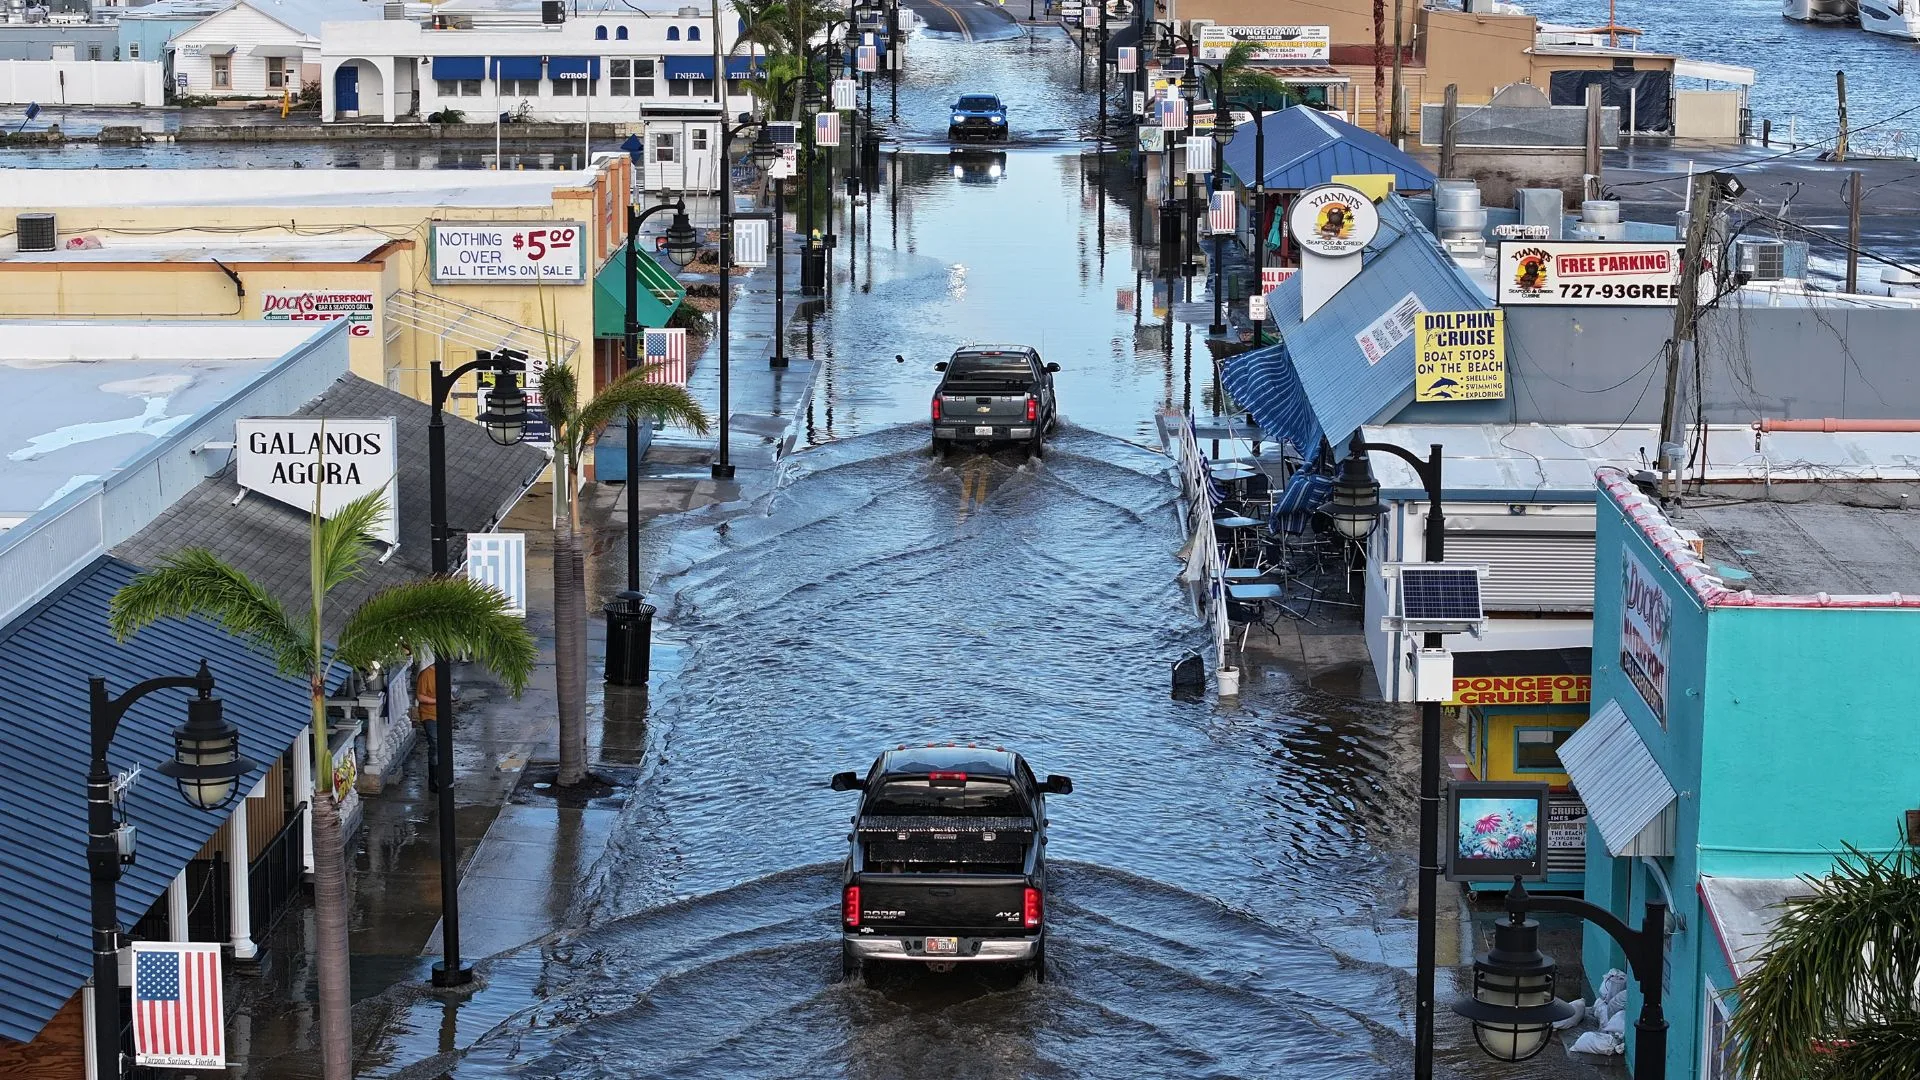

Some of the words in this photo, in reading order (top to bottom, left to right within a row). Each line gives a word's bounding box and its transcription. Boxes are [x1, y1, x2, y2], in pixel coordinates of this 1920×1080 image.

[1227, 26, 1302, 36] SPONGEORAMA
[1135, 104, 1142, 112] 15
[1309, 193, 1362, 210] YIANNI'S
[440, 232, 502, 246] NOTHING
[460, 250, 502, 264] OVER
[1511, 248, 1553, 262] YIANNI'S
[442, 266, 466, 276] ALL
[473, 266, 516, 276] ITEMS
[520, 266, 537, 276] ON
[543, 266, 573, 276] SALE
[1561, 256, 1596, 274] FREE
[1600, 254, 1666, 272] PARKING
[1261, 272, 1276, 282] ALL
[316, 294, 372, 302] WATERFRONT
[1558, 284, 1680, 299] 727-93GREE
[1424, 312, 1495, 330] DOLPHIN
[1438, 330, 1496, 346] CRUISE
[1424, 351, 1453, 362] BOAT
[1460, 350, 1495, 360] STOPS
[1418, 364, 1434, 374] ON
[1441, 363, 1462, 373] THE
[1468, 362, 1503, 372] BEACH
[526, 393, 544, 404] ale
[250, 432, 381, 455] GALANOS
[270, 462, 362, 484] AGORA
[1453, 676, 1591, 692] PONGEOR
[1460, 690, 1554, 704] CRUISE
[144, 1056, 166, 1065] Tarpon
[195, 1058, 216, 1066] Florida
